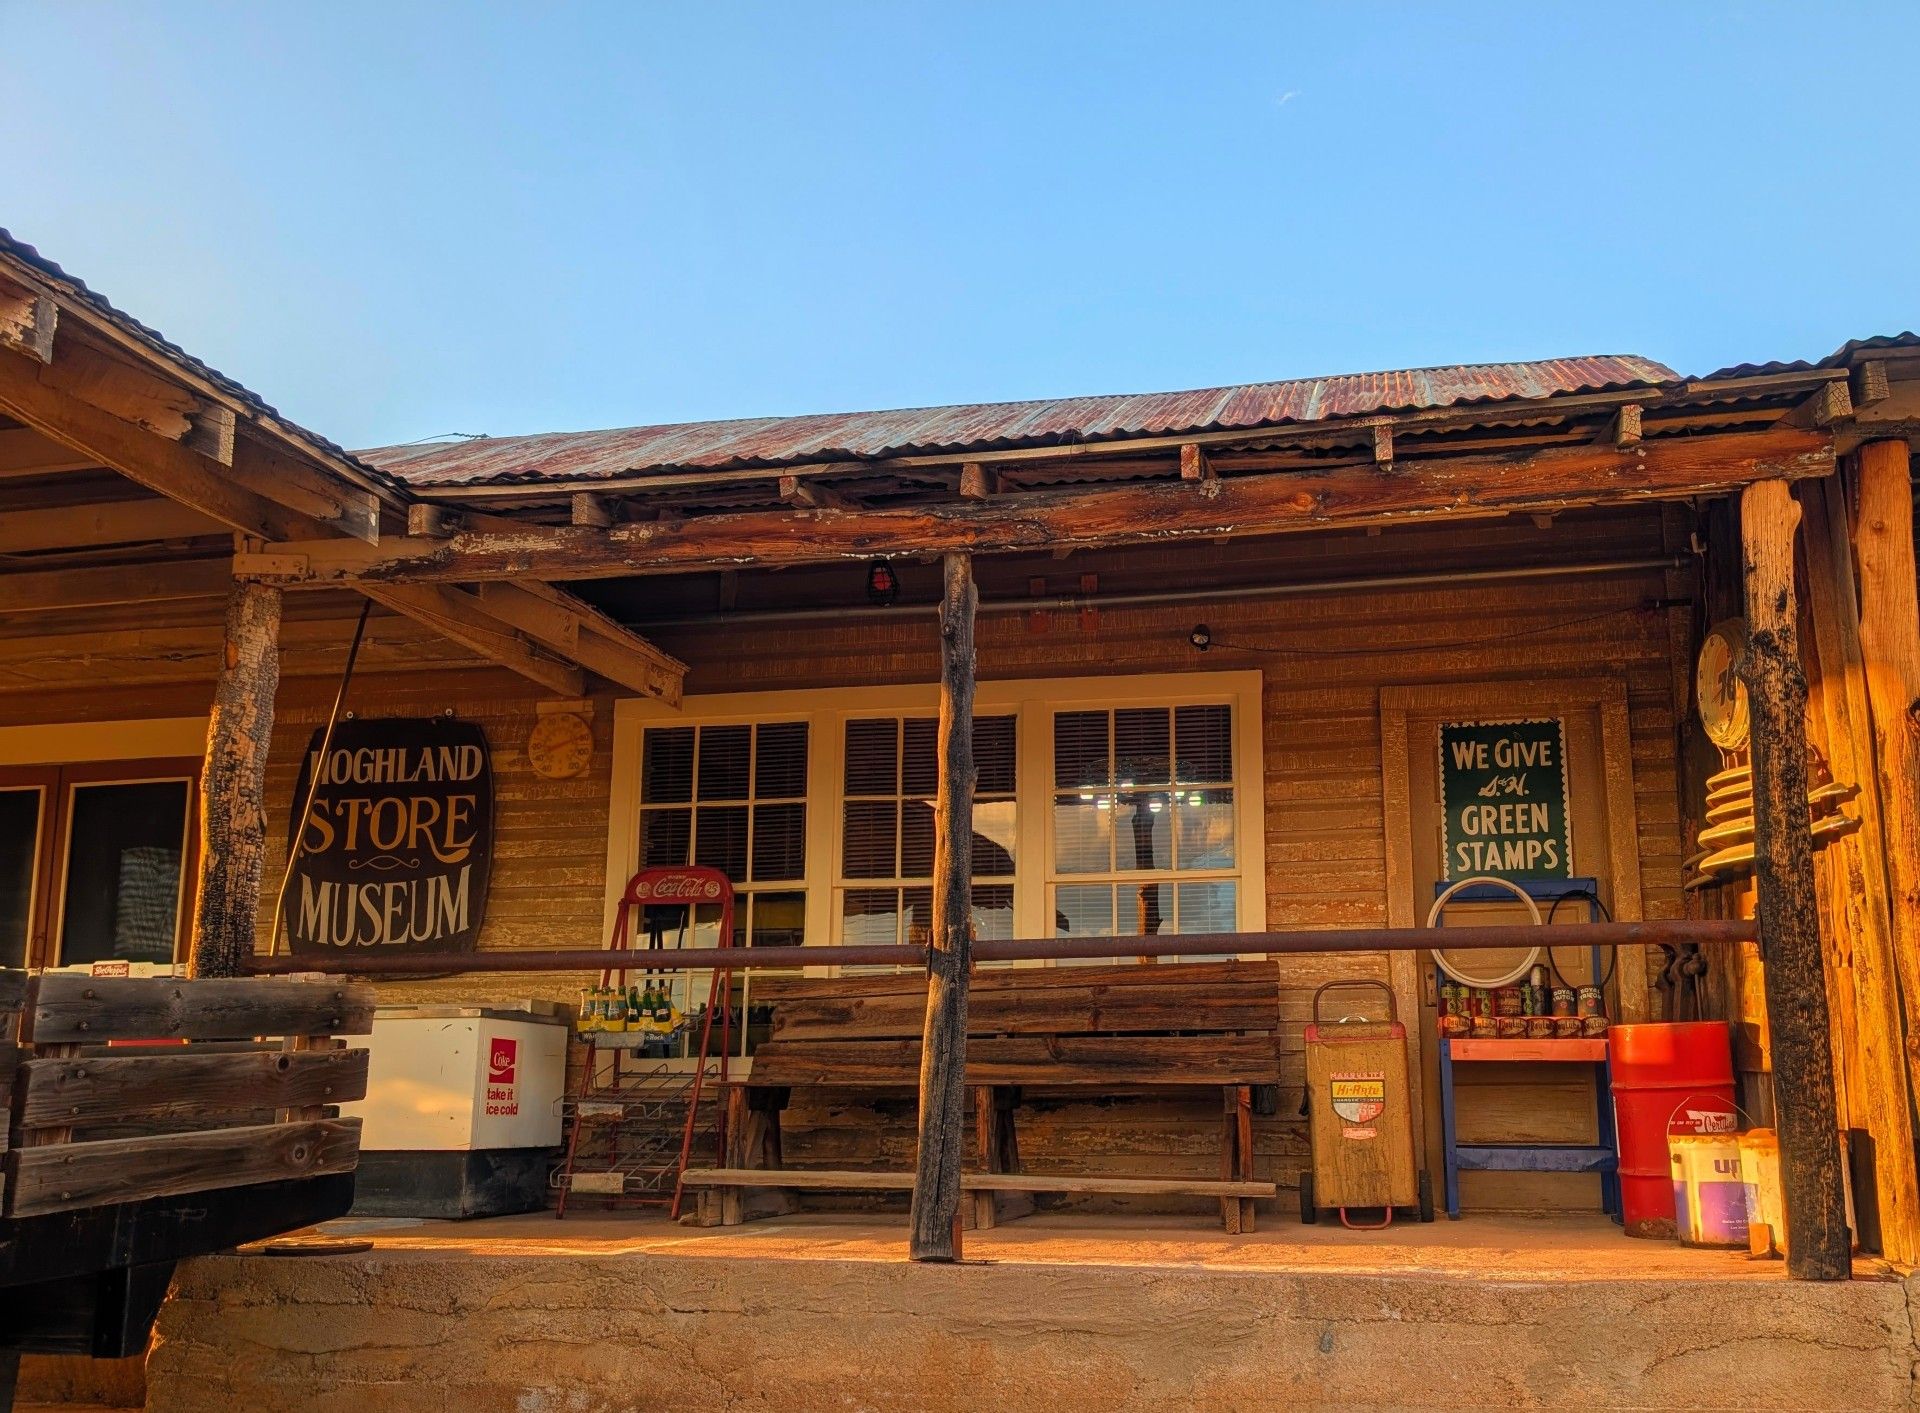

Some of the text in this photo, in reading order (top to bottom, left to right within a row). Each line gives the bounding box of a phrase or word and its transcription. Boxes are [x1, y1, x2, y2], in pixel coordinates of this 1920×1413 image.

[309, 745, 483, 784] HOGHLAND
[1451, 738, 1553, 770] WE GIVE
[299, 795, 478, 864] STORE
[1461, 803, 1549, 836] GREEN
[1456, 839, 1559, 872] STAMPS
[297, 864, 472, 947] MUSEUM
[485, 1102, 518, 1115] ice cold
[487, 1088, 514, 1101] take it
